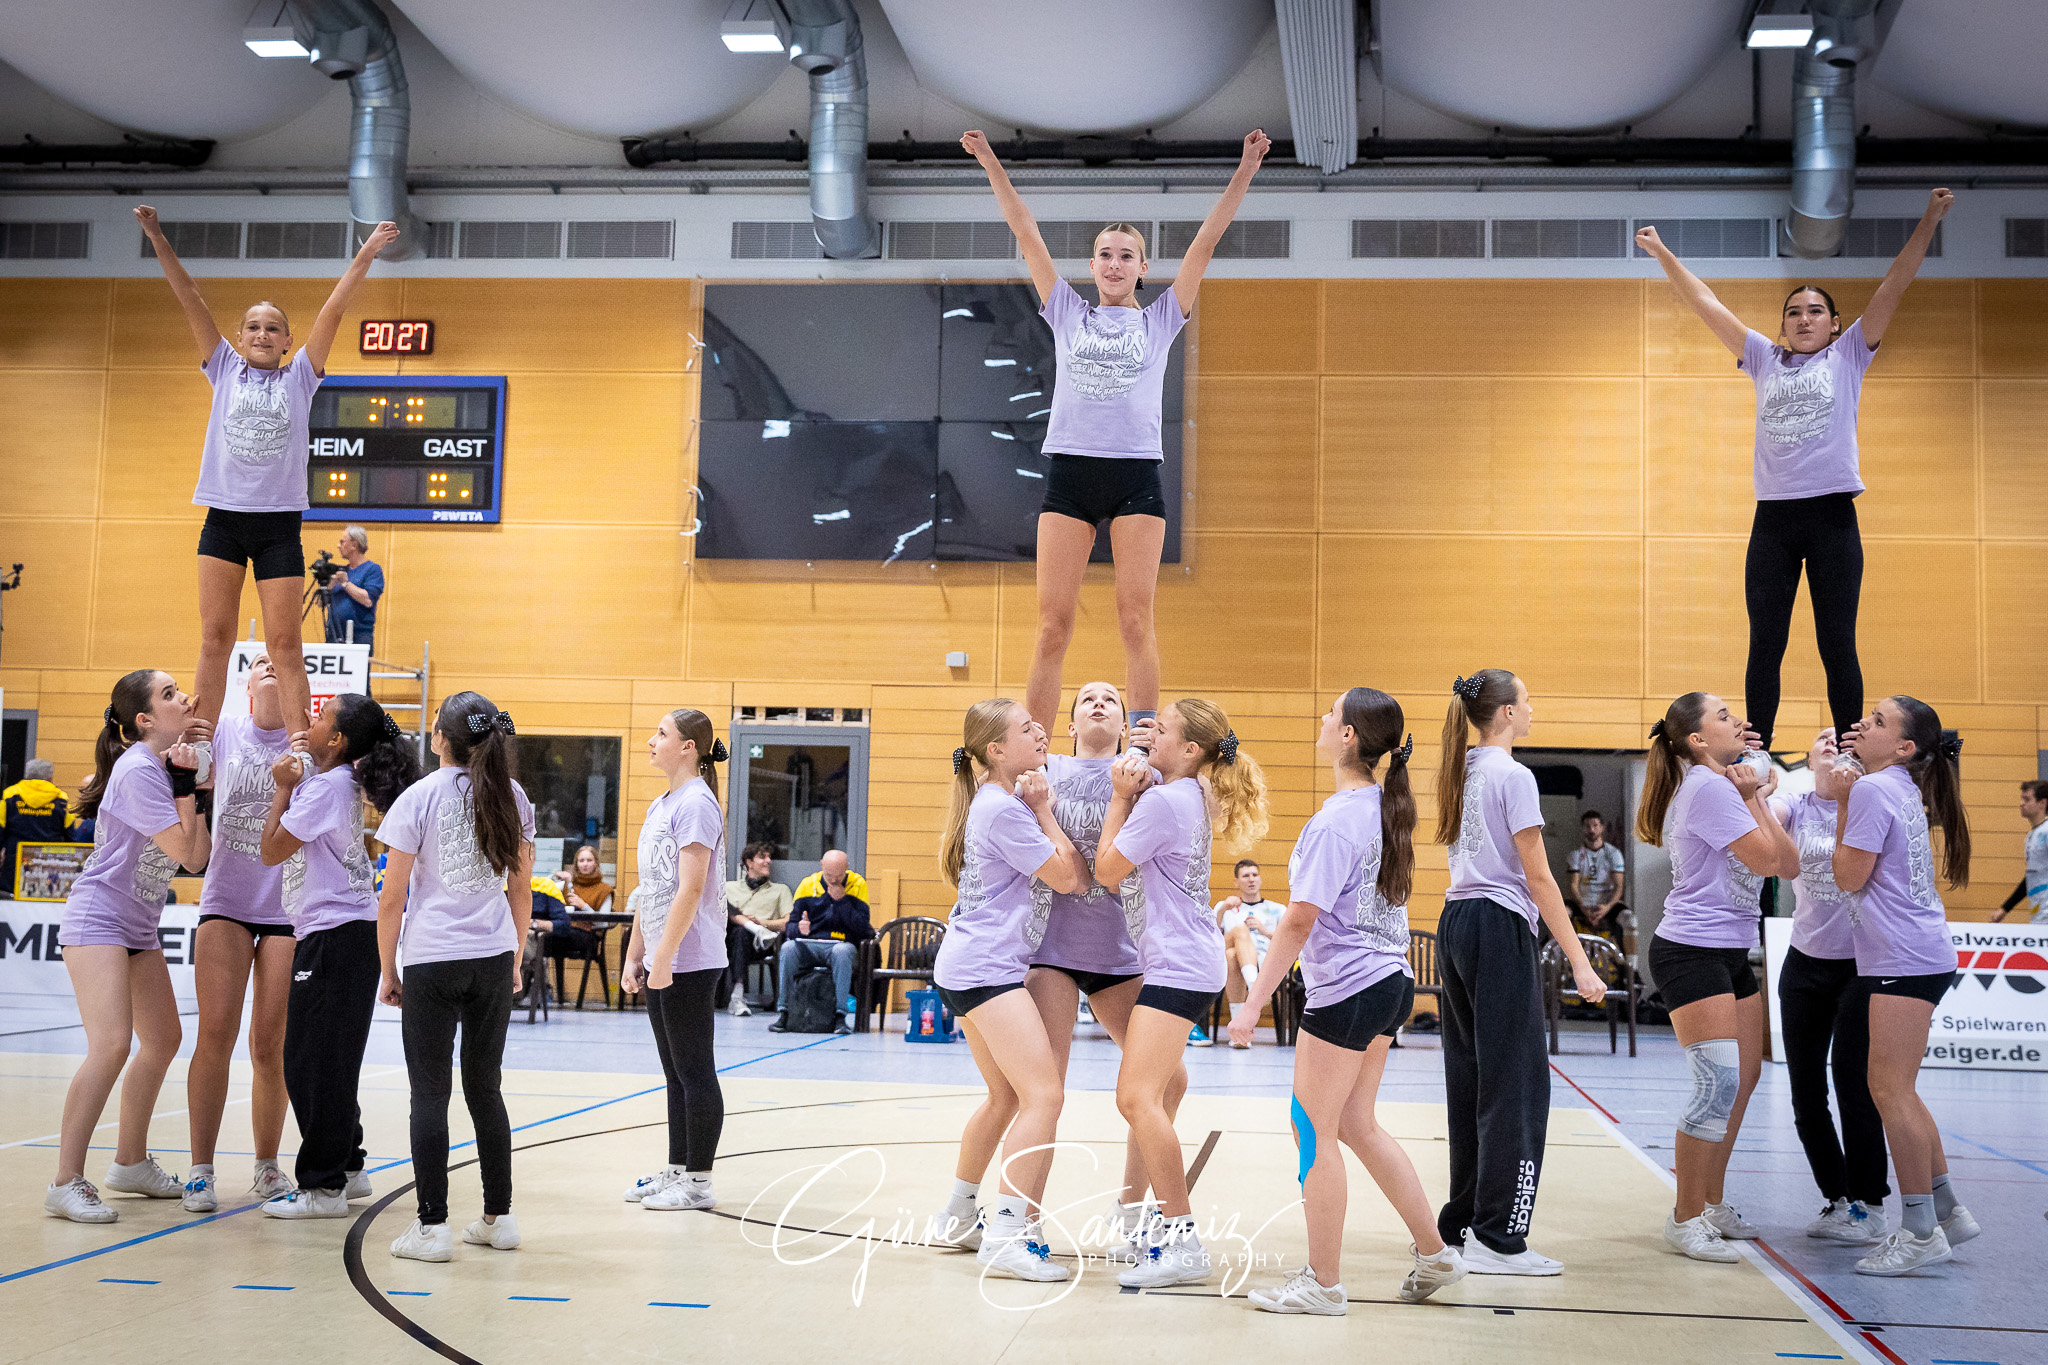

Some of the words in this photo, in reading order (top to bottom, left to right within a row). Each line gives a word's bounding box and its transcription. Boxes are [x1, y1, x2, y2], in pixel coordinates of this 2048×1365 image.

[424, 438, 487, 458] GAST
[432, 510, 483, 521] PEWETA
[238, 653, 353, 675] MSEL
[244, 817, 266, 832] WATC
[1951, 933, 2048, 947] elwaren
[1942, 1016, 2047, 1032] Spielwaren
[1924, 1043, 2040, 1064] eiger.de
[1506, 1159, 1526, 1234] SPORTSWEAR
[1513, 1160, 1536, 1234] adidas
